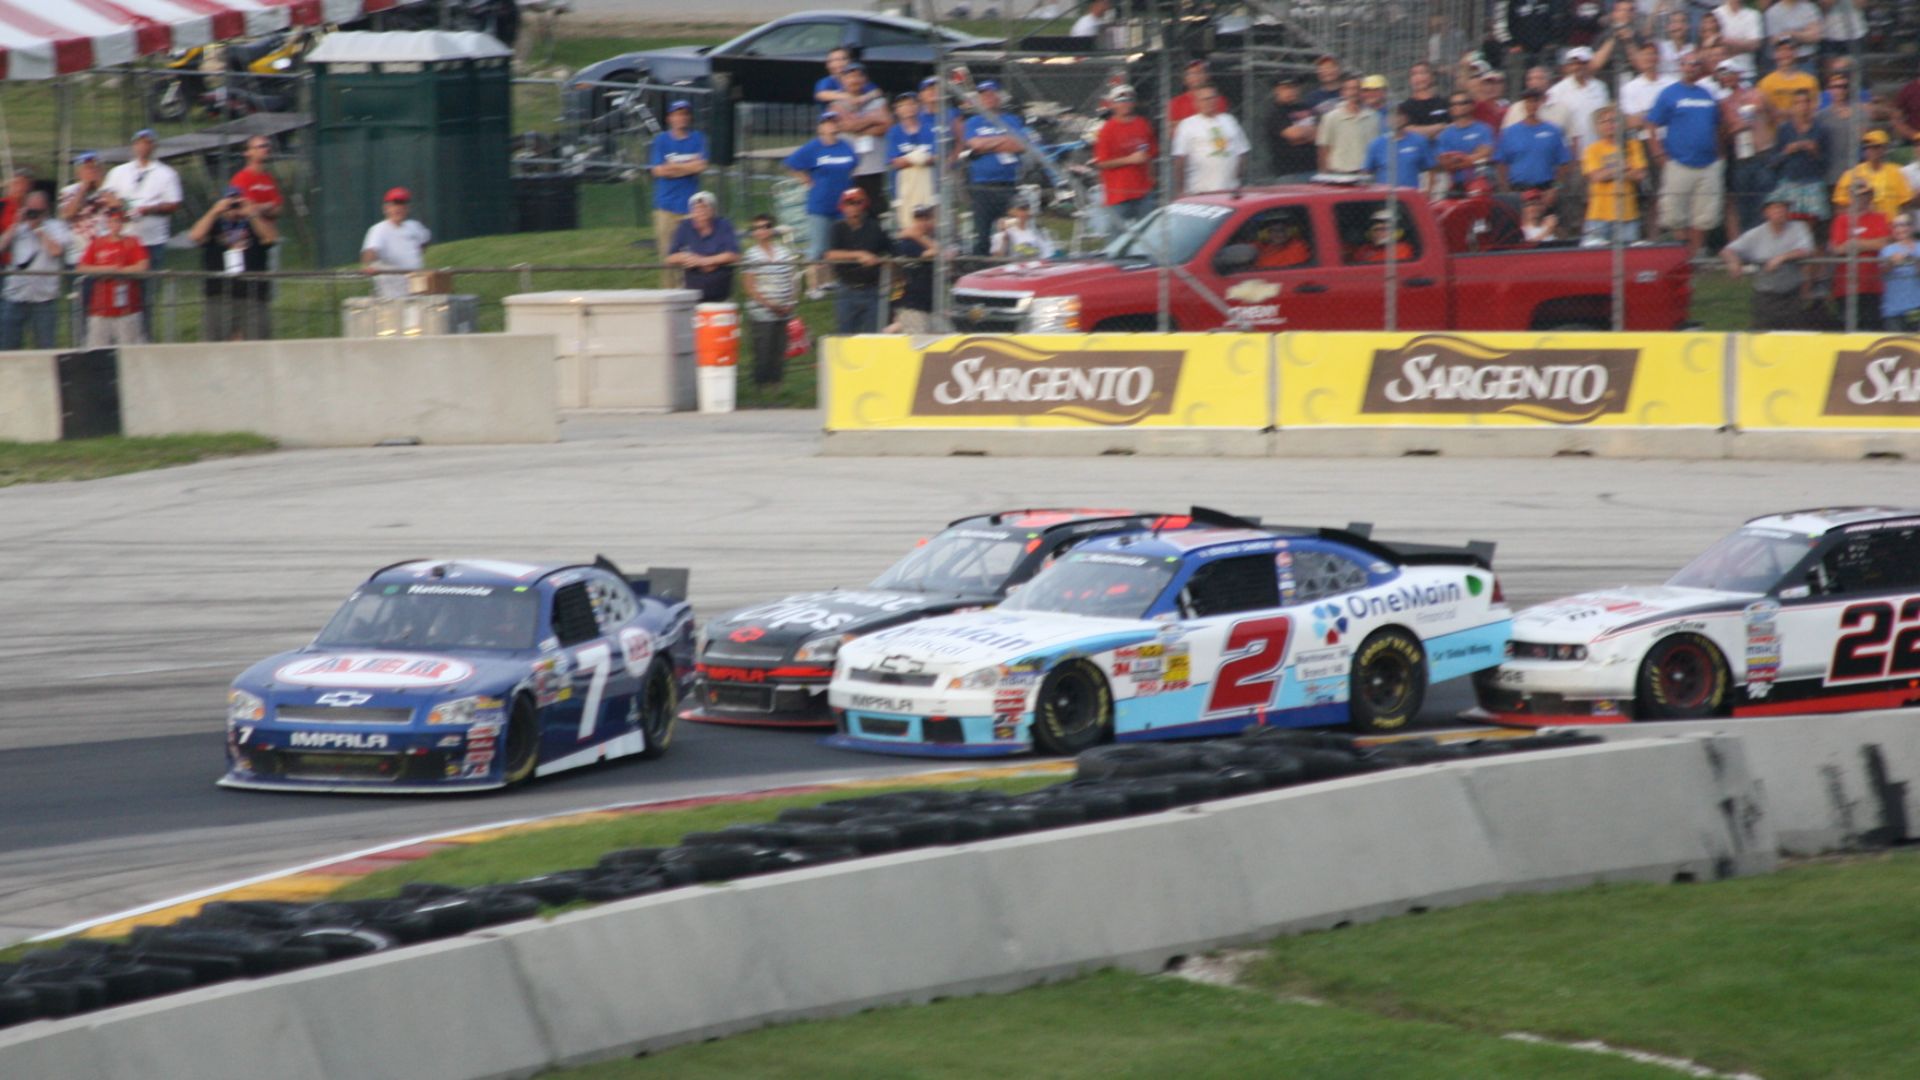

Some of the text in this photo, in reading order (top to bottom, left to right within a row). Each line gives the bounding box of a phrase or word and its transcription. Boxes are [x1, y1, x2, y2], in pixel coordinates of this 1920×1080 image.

[933, 356, 1154, 405] SARGENTO
[1385, 354, 1609, 405] SARGENTO
[407, 584, 494, 597] Nationwide
[1347, 582, 1461, 619] OneMain
[1205, 615, 1292, 715] 2
[576, 642, 610, 741] 7
[851, 694, 915, 712] IMPALA
[237, 727, 253, 744] 7
[289, 731, 390, 749] IMPALA
